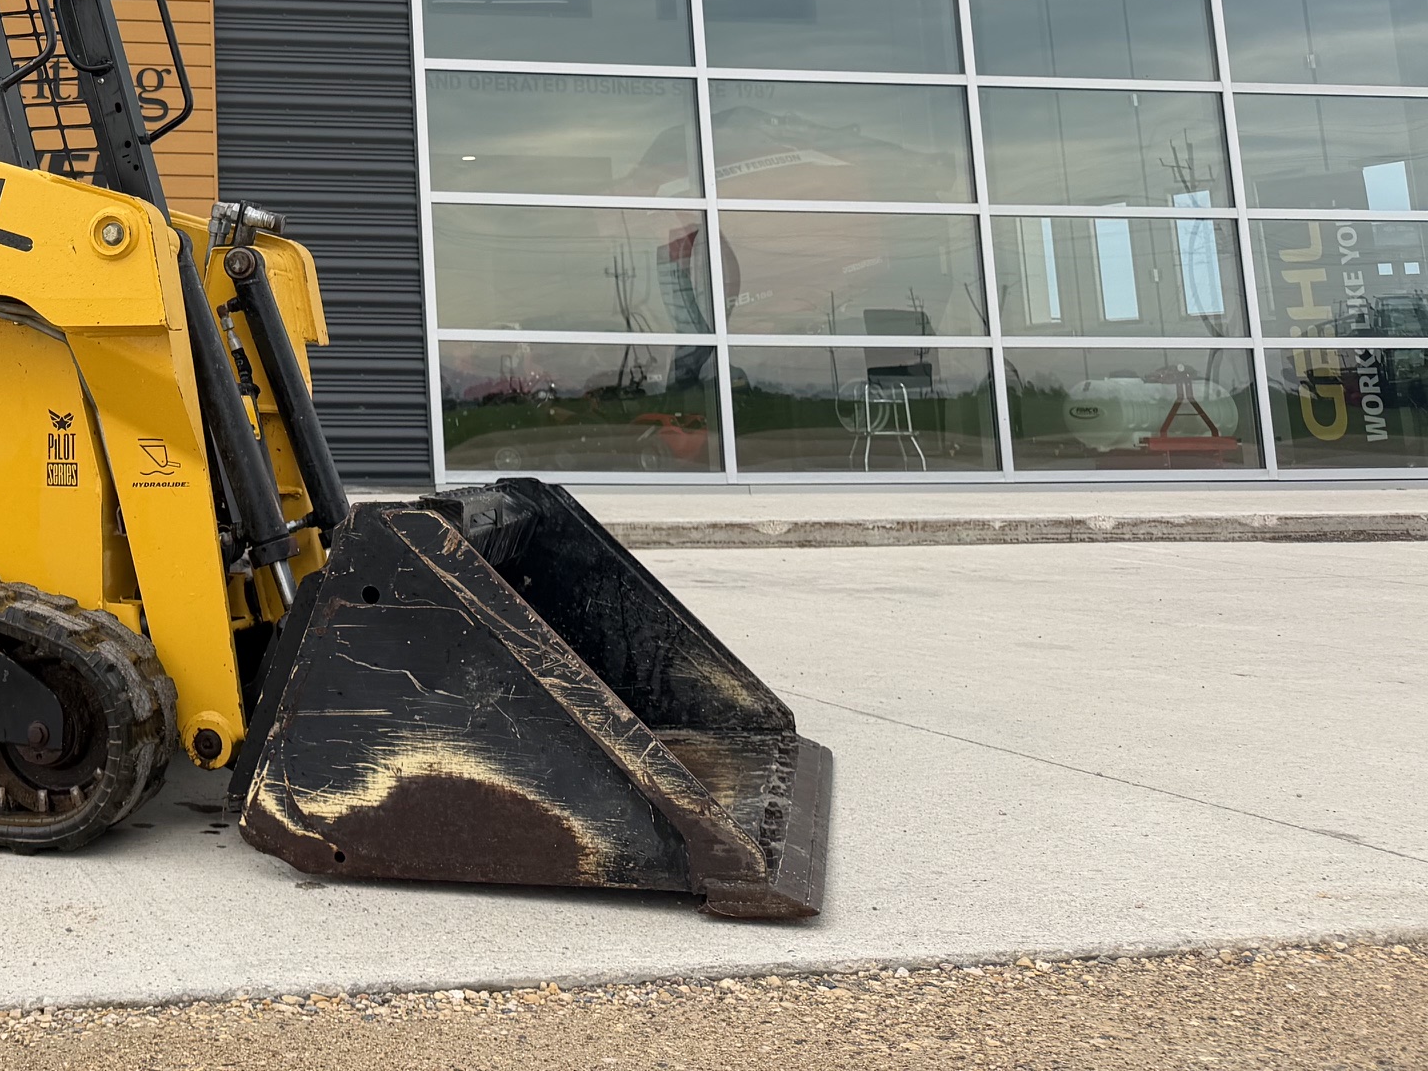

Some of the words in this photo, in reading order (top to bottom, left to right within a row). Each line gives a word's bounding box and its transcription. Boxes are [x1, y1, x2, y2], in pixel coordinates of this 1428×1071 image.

[468, 75, 568, 94] OPERATED
[573, 77, 667, 97] BUSINESS
[1335, 221, 1362, 266] YO
[1278, 201, 1349, 442] GEHL
[1341, 269, 1372, 330] LIKE
